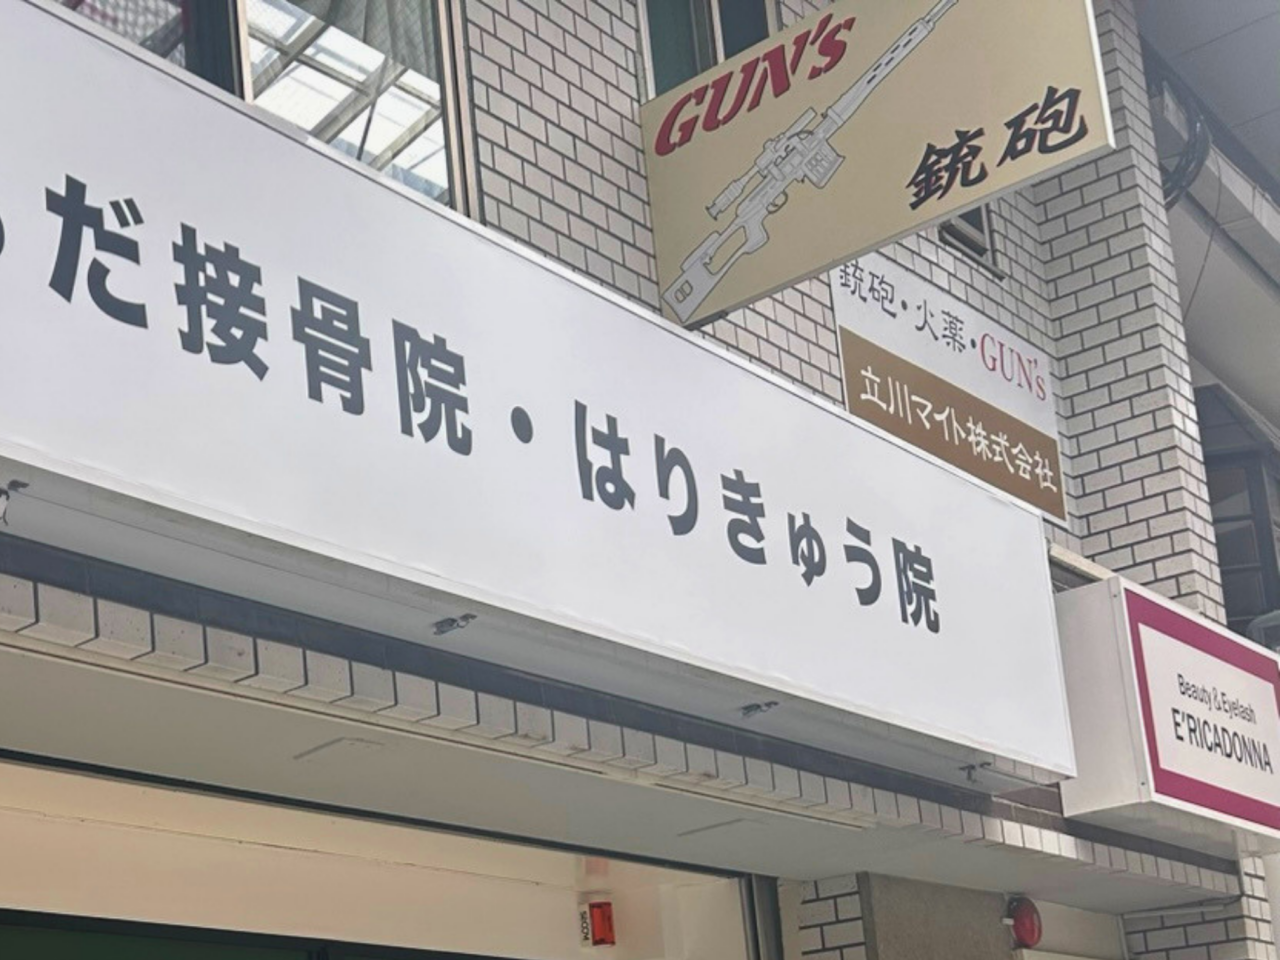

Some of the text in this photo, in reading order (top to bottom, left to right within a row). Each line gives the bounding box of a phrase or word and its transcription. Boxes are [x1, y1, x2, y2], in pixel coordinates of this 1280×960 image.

[905, 86, 1089, 211] 銃砲
[859, 364, 1058, 494] 立川マイト株式会社
[1177, 673, 1212, 711] Beauty
[1221, 691, 1257, 725] Eyelash
